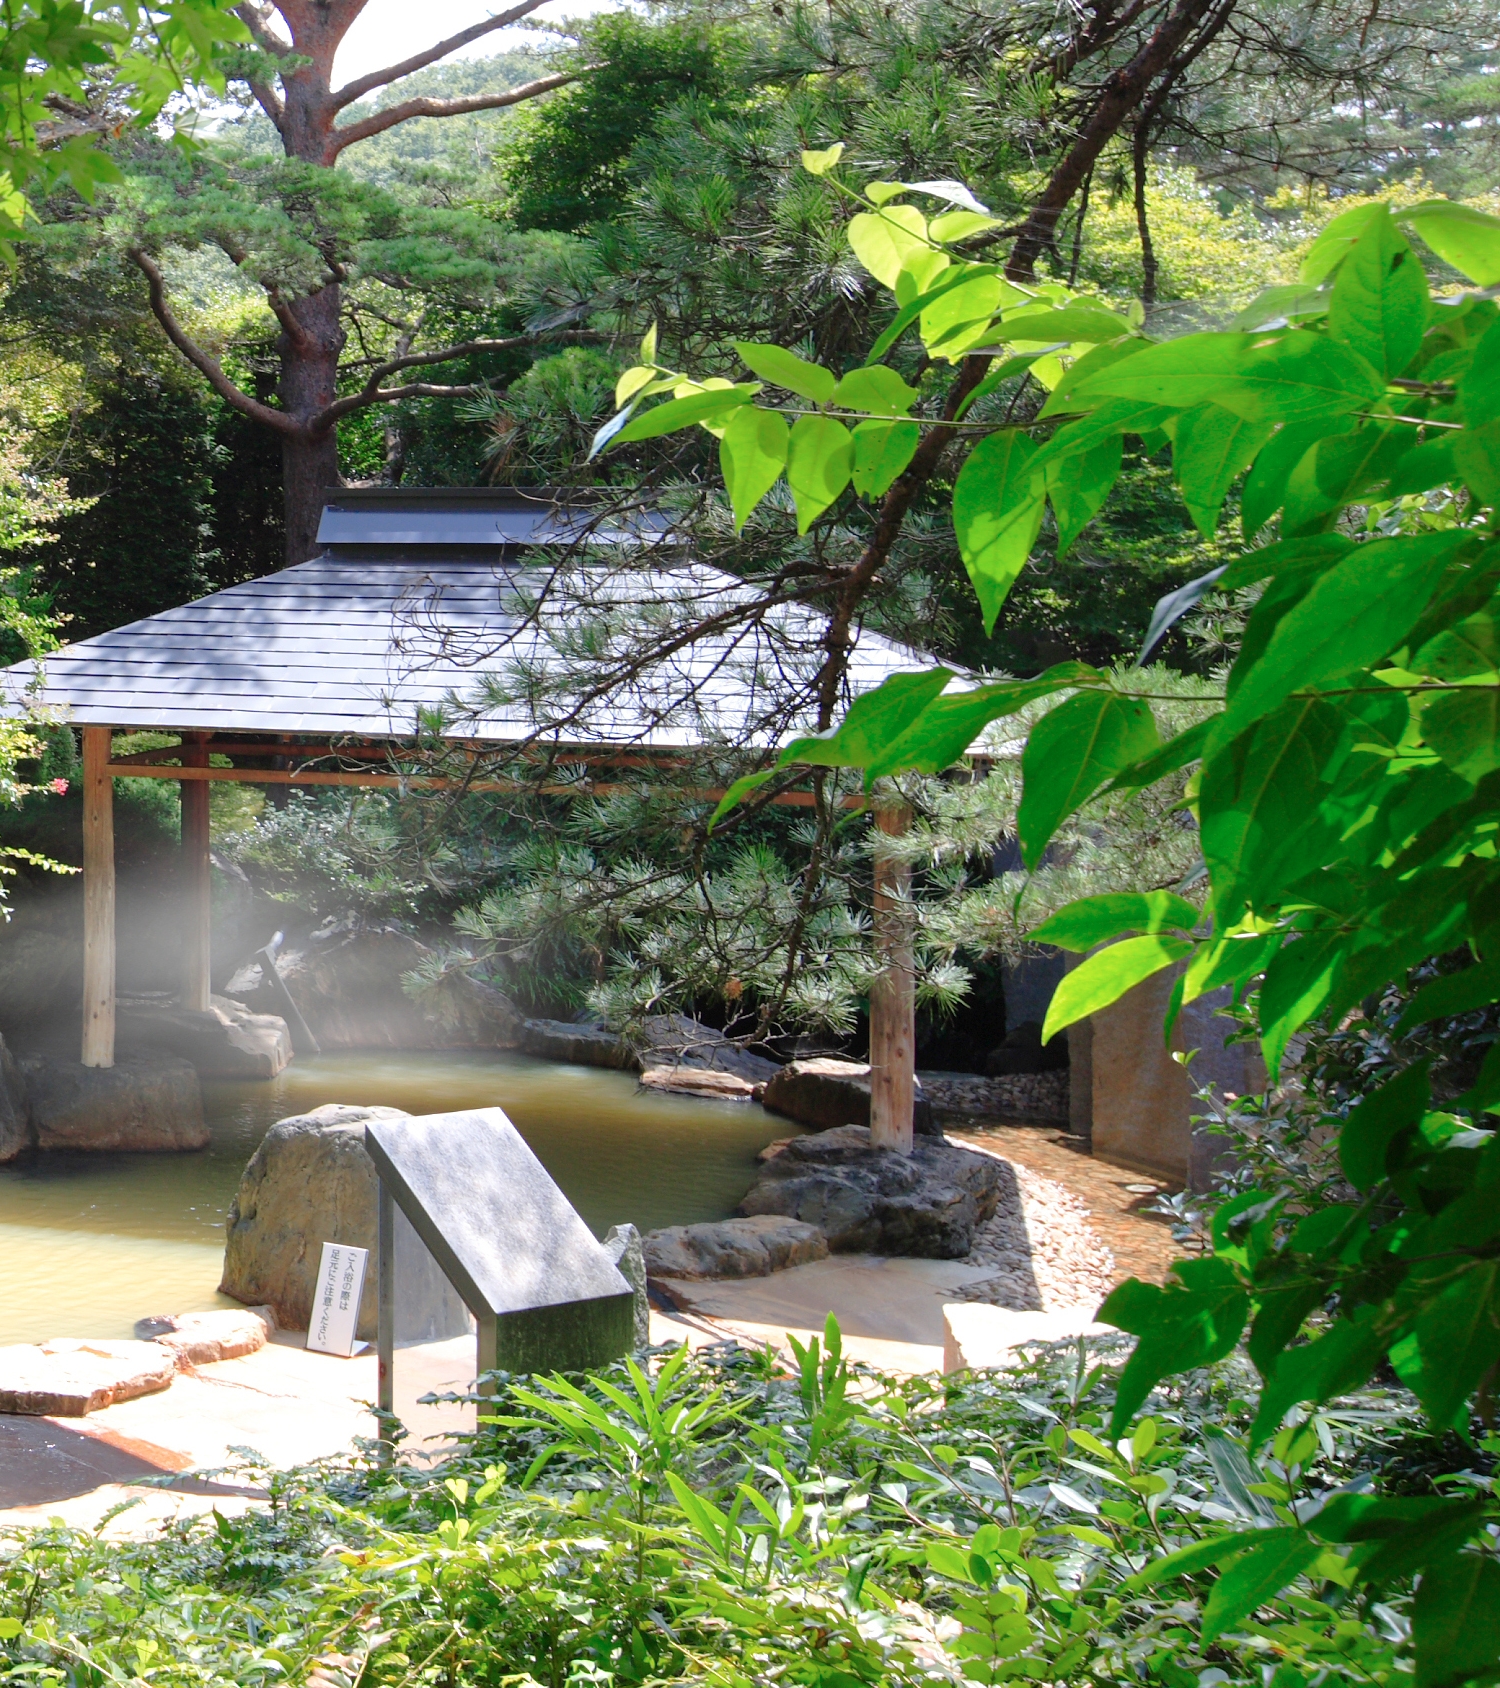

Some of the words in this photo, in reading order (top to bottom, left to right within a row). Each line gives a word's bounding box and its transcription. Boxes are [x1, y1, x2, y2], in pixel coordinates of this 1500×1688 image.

[317, 1249, 340, 1346] 足元にご注意ください。
[339, 1252, 357, 1311] ご入浴の際は
